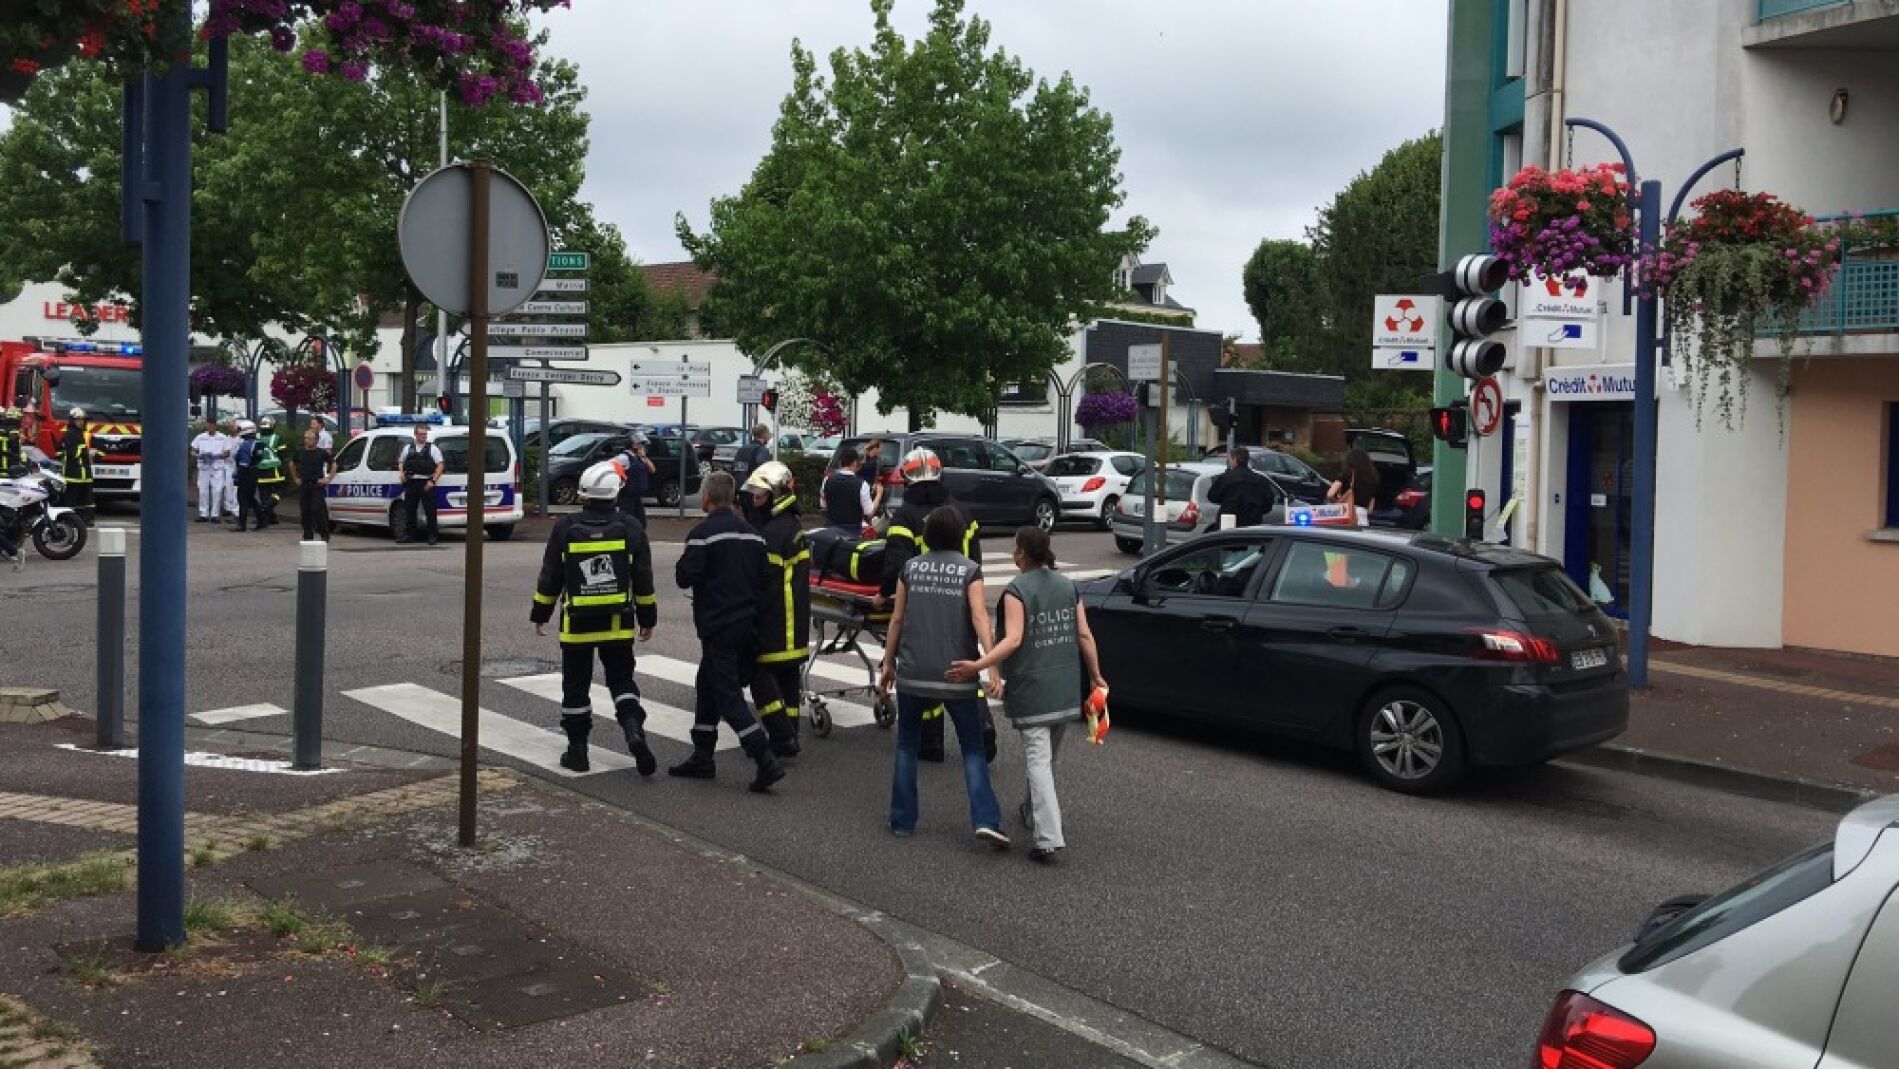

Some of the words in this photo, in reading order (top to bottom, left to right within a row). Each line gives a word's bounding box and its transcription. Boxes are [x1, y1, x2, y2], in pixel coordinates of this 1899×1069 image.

[551, 256, 584, 266] TIONS
[1549, 377, 1587, 394] Crédit
[1602, 375, 1635, 392] Mutu
[347, 485, 382, 497] POLICE
[910, 561, 968, 576] POLICE
